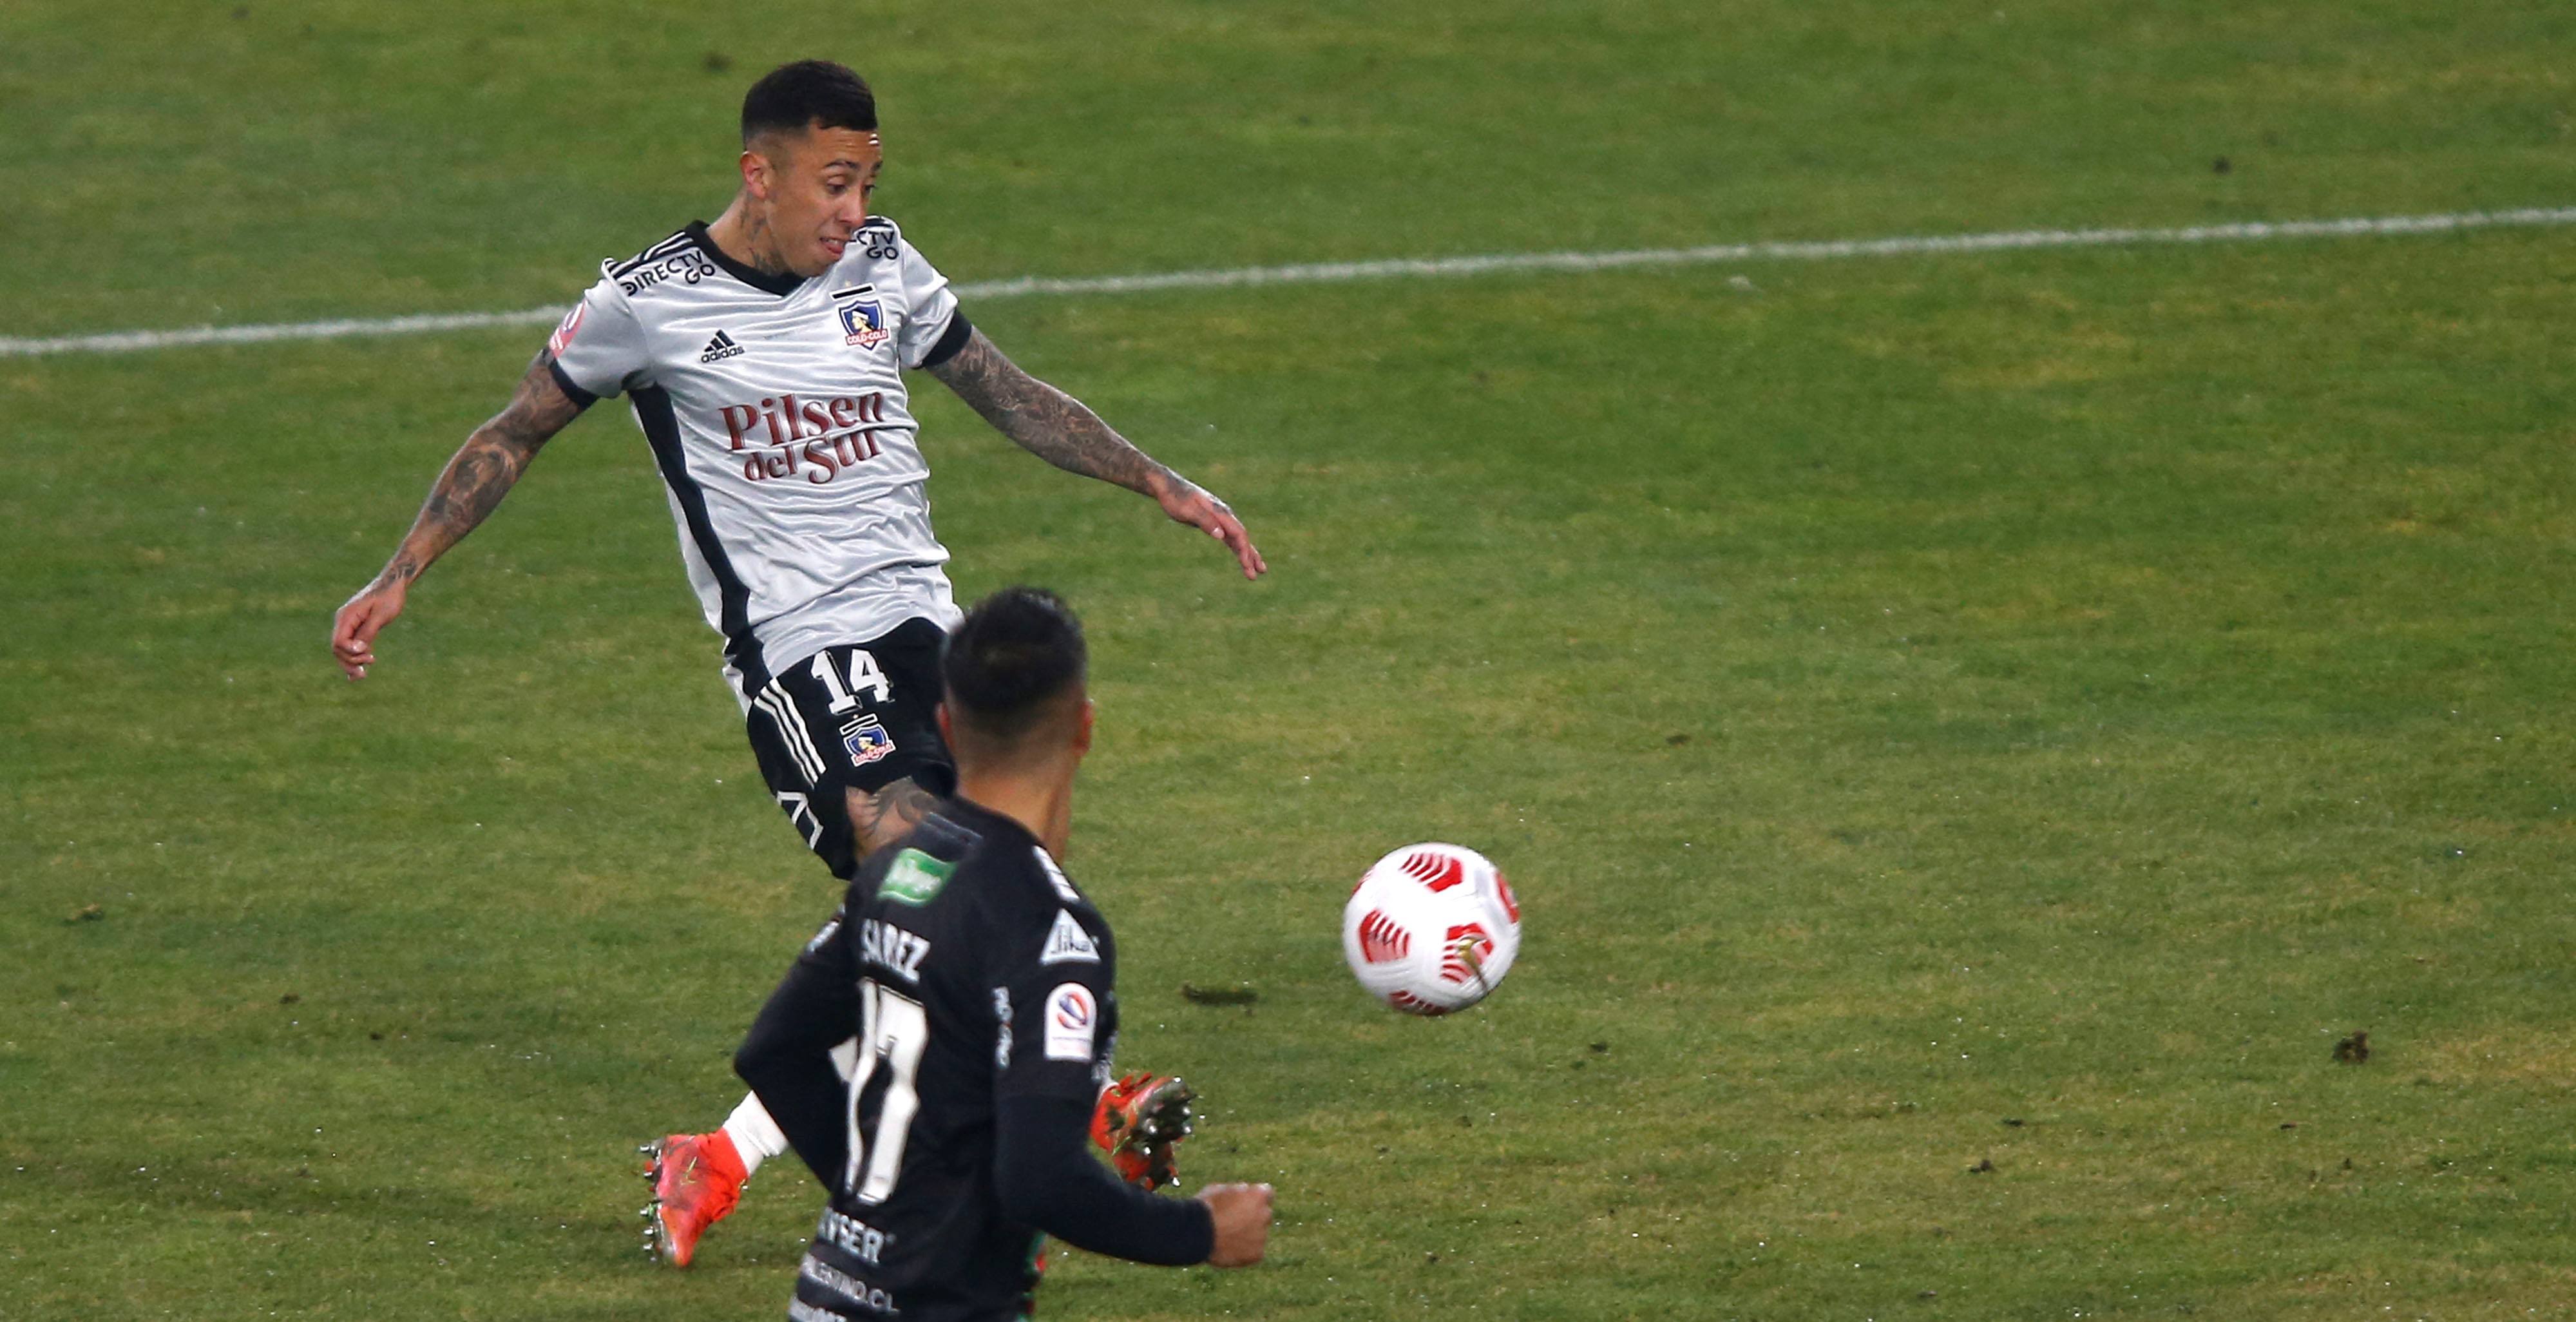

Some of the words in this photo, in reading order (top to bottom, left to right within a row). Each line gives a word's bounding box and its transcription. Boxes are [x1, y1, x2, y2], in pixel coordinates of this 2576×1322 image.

[620, 251, 703, 297] DIRECTV
[685, 264, 716, 284] GO
[866, 246, 899, 260] GO
[701, 347, 745, 363] adidas
[718, 392, 885, 452] Pilsen
[745, 446, 797, 481] del
[804, 429, 883, 484] Sur
[811, 649, 894, 715] 14
[829, 976, 929, 1206] 17
